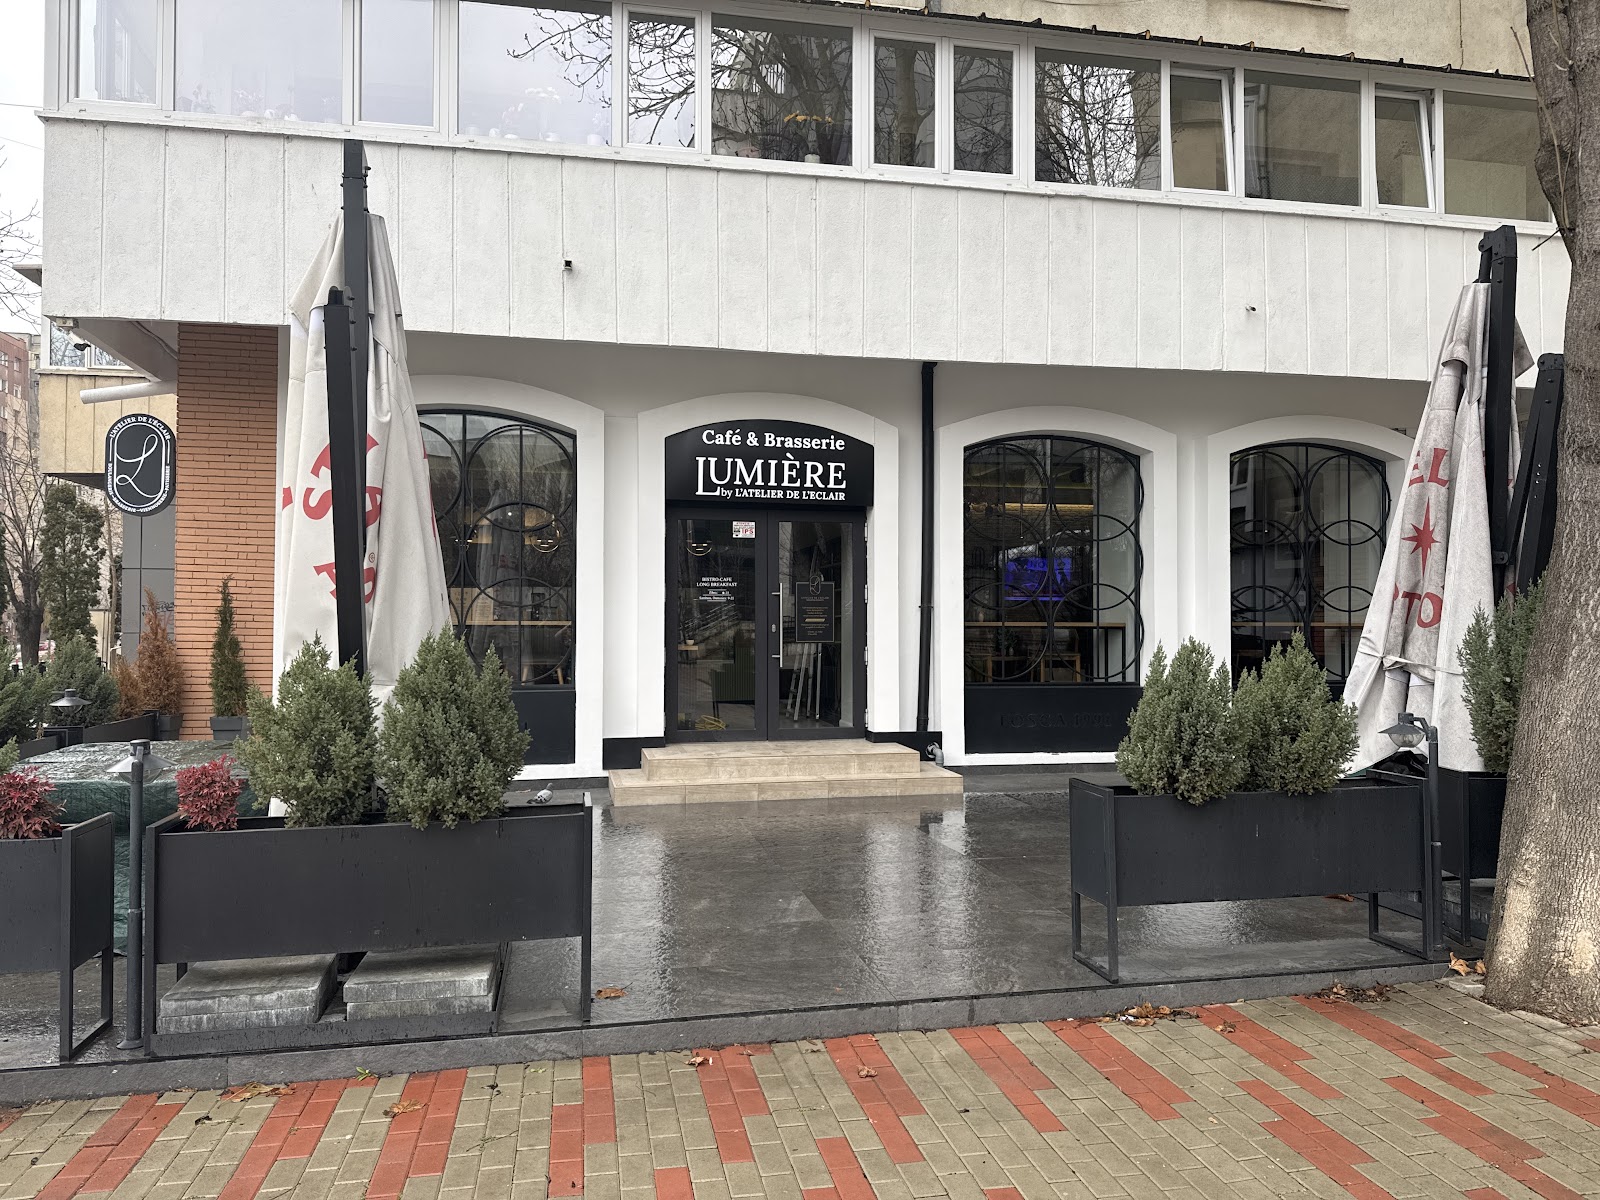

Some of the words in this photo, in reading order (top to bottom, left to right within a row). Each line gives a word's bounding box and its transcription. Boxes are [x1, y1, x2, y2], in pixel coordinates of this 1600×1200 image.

[109, 416, 137, 439] L'ATELIER
[702, 428, 742, 446] Café
[746, 431, 760, 447] &
[764, 432, 846, 451] Brasserie
[695, 452, 847, 496] LUMIÈRE
[720, 486, 733, 500] by
[735, 488, 785, 499] L'ATELIER
[786, 489, 800, 499] DE
